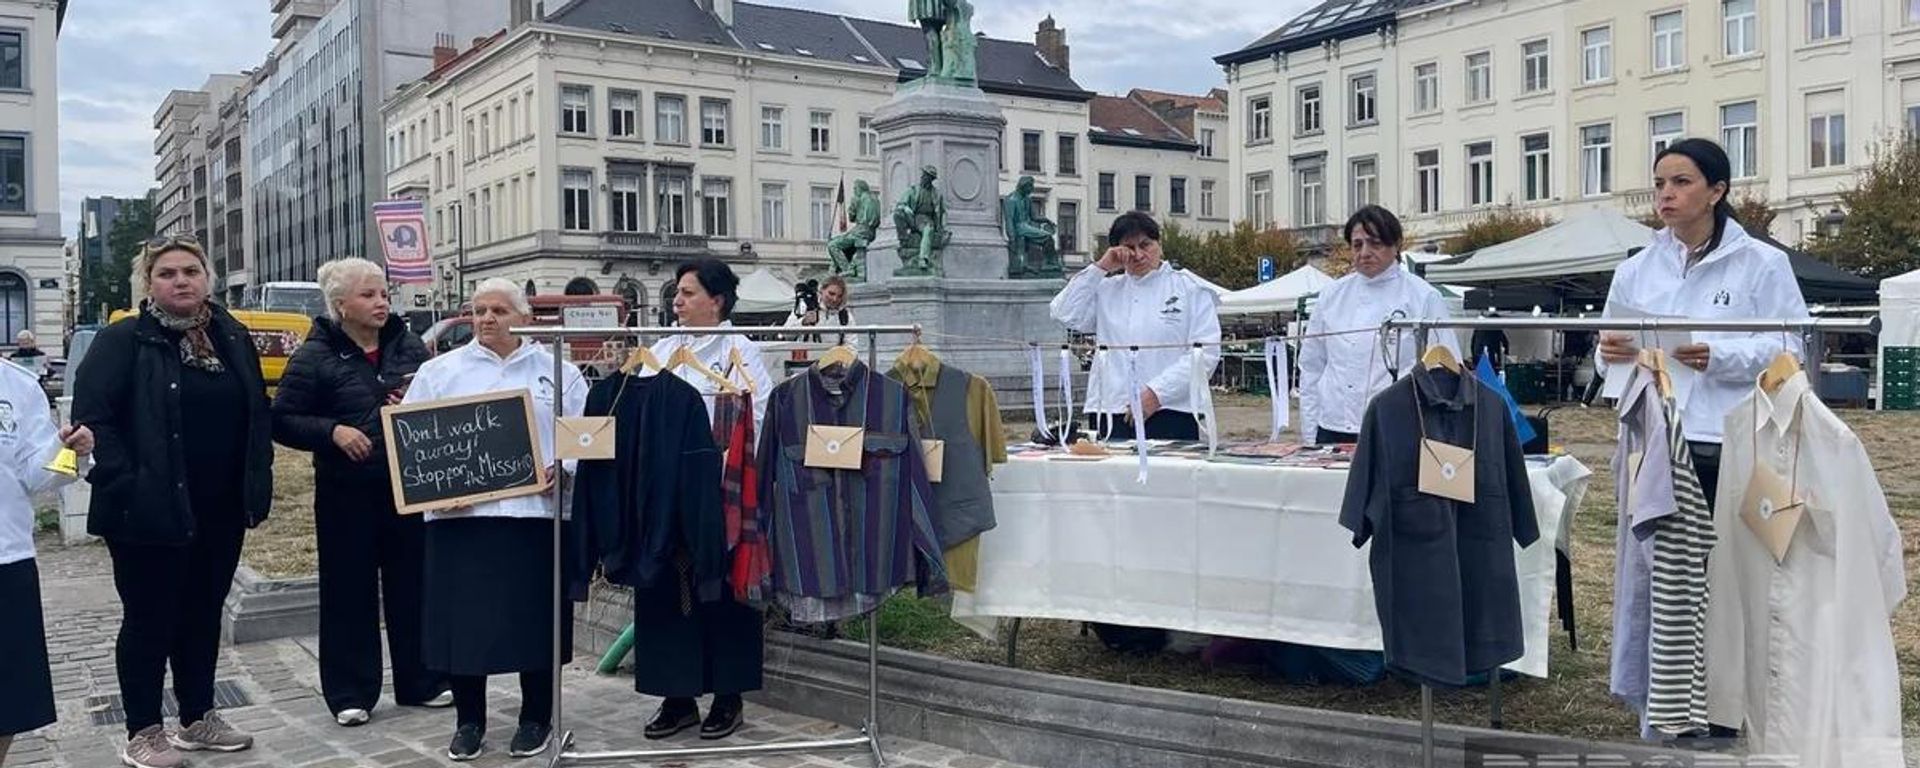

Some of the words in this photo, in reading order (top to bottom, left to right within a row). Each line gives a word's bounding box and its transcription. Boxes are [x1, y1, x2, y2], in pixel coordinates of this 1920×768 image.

[1262, 258, 1270, 272] P
[447, 405, 502, 437] walk
[403, 464, 445, 492] Stop
